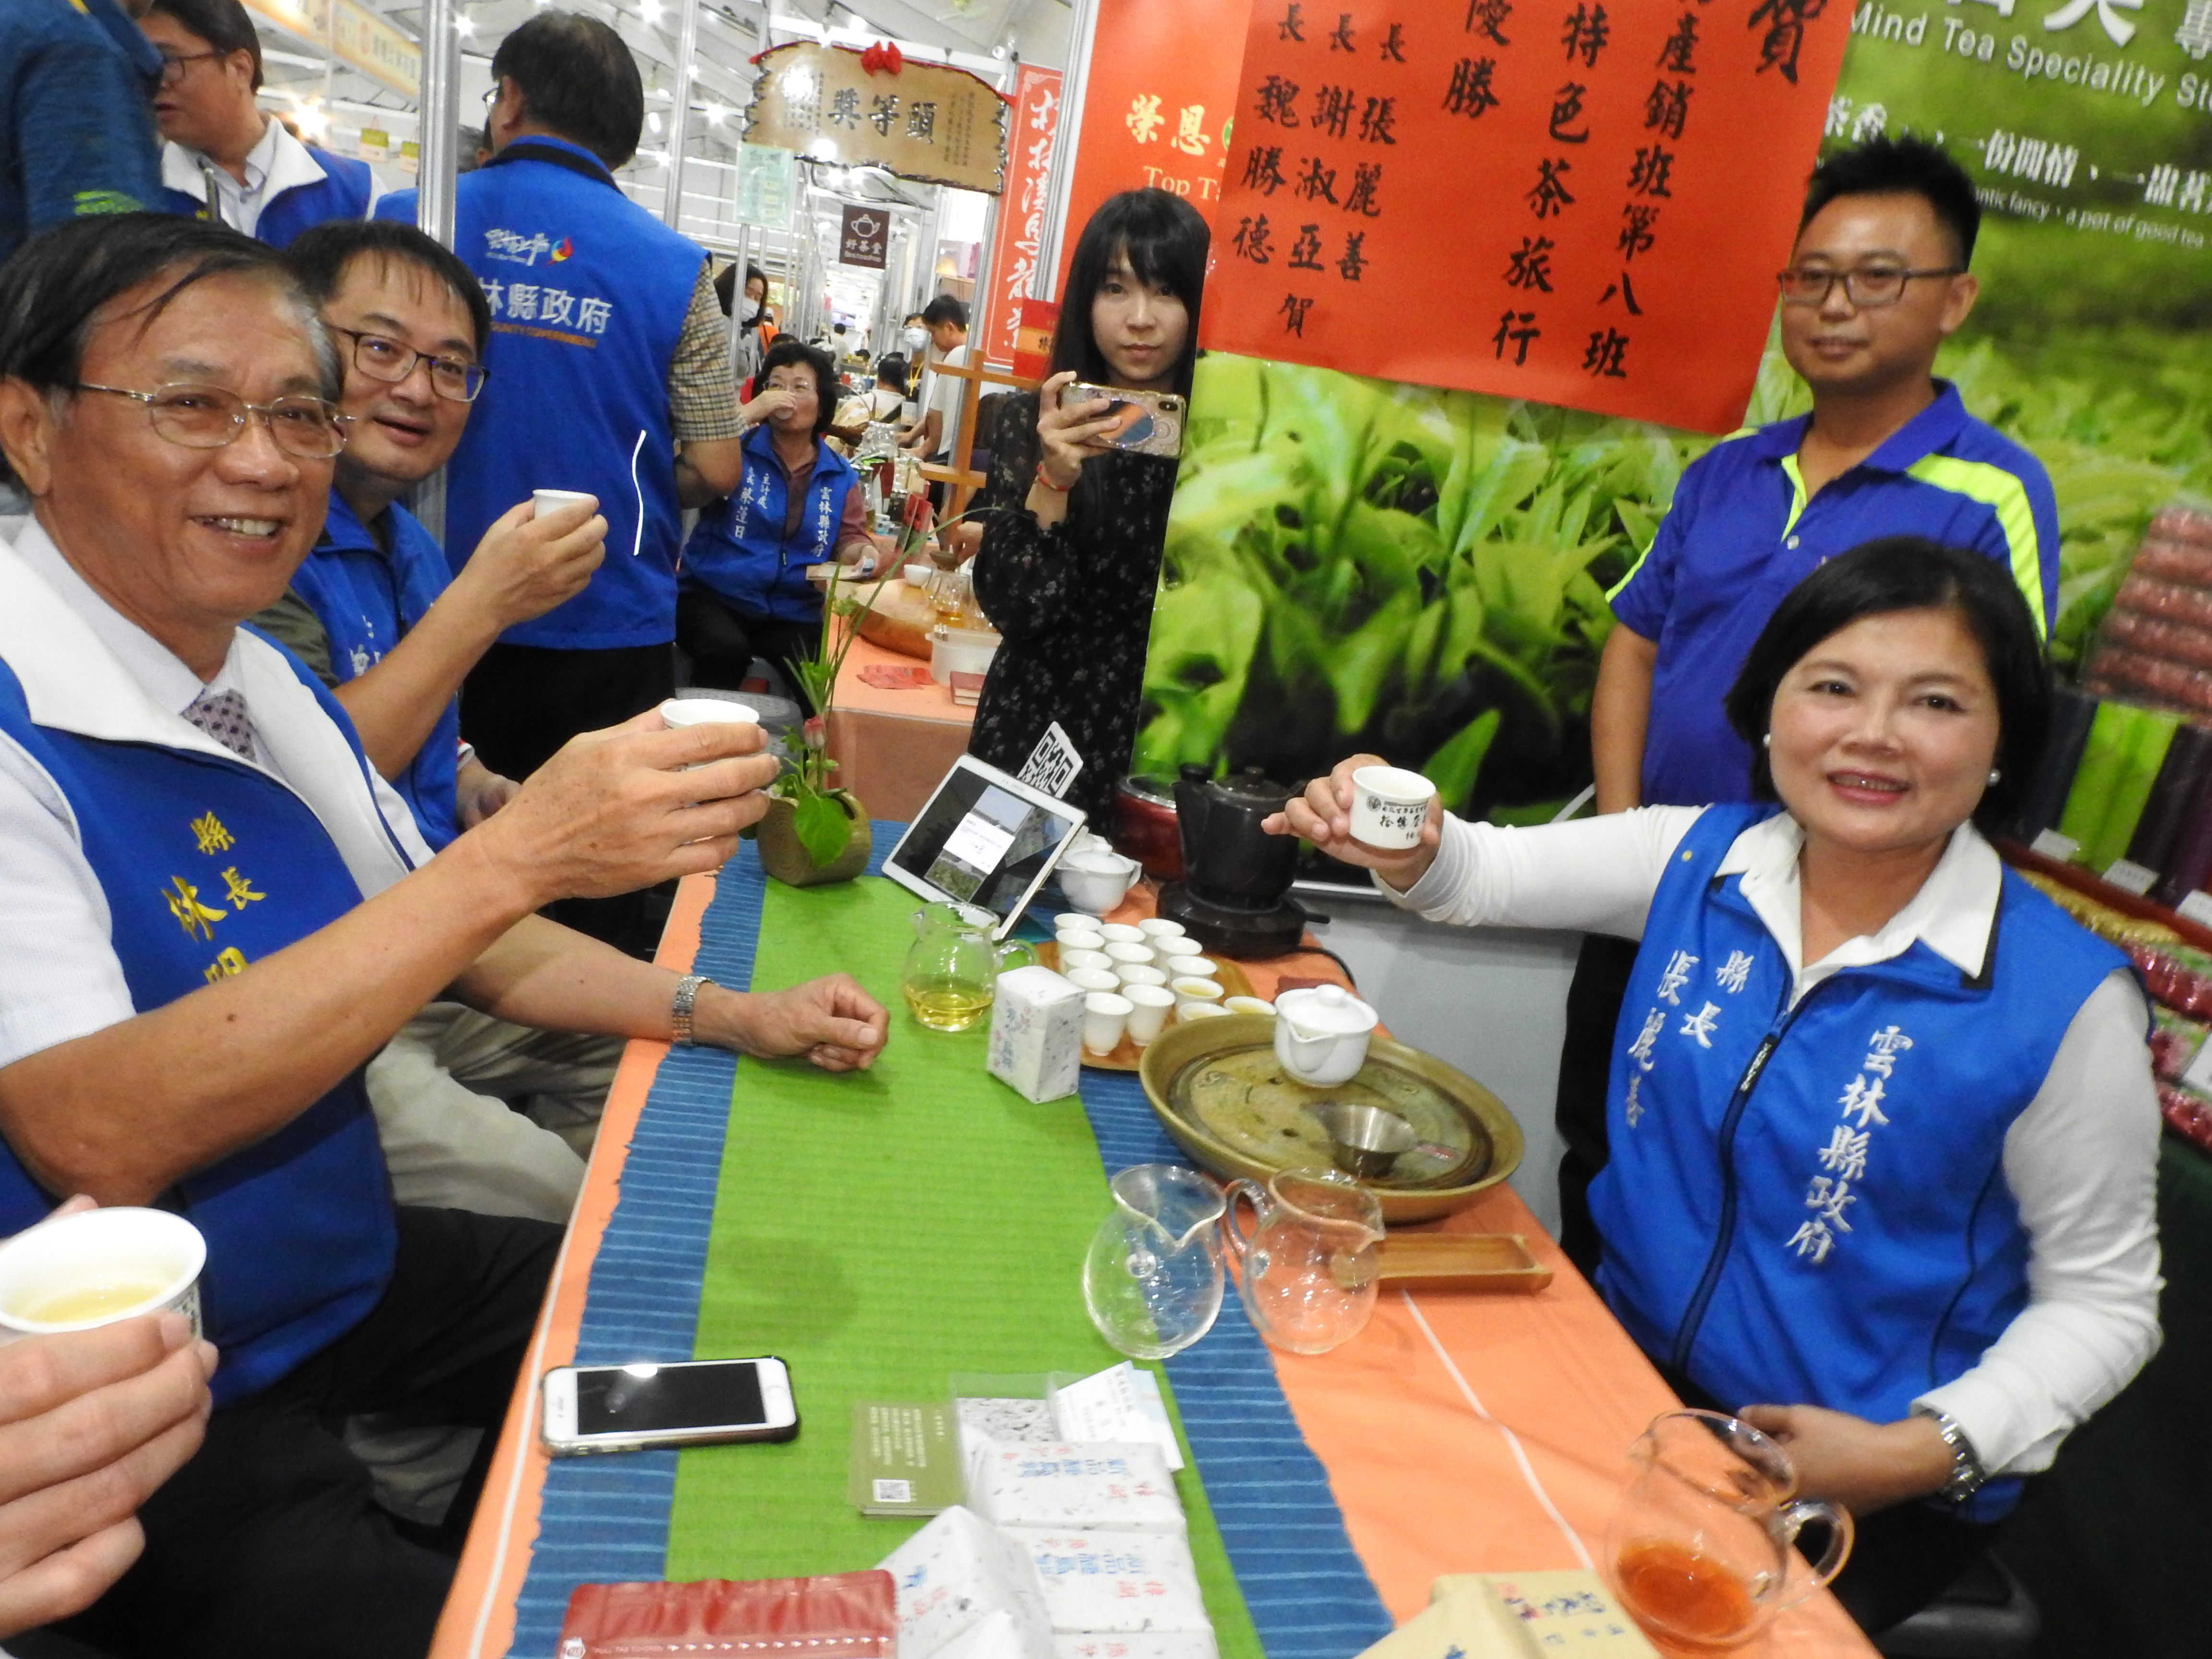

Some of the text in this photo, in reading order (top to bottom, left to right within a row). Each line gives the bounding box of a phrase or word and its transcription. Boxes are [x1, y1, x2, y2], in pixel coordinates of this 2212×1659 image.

[1125, 94, 1211, 156] 榮恩
[1491, 2, 1610, 366] 特色茶旅行
[1582, 0, 1714, 378] 產銷班第八班
[1277, 293, 1314, 338] 賀
[1679, 950, 1755, 1049] 縣長
[1784, 1025, 1914, 1263] 雲林縣政府
